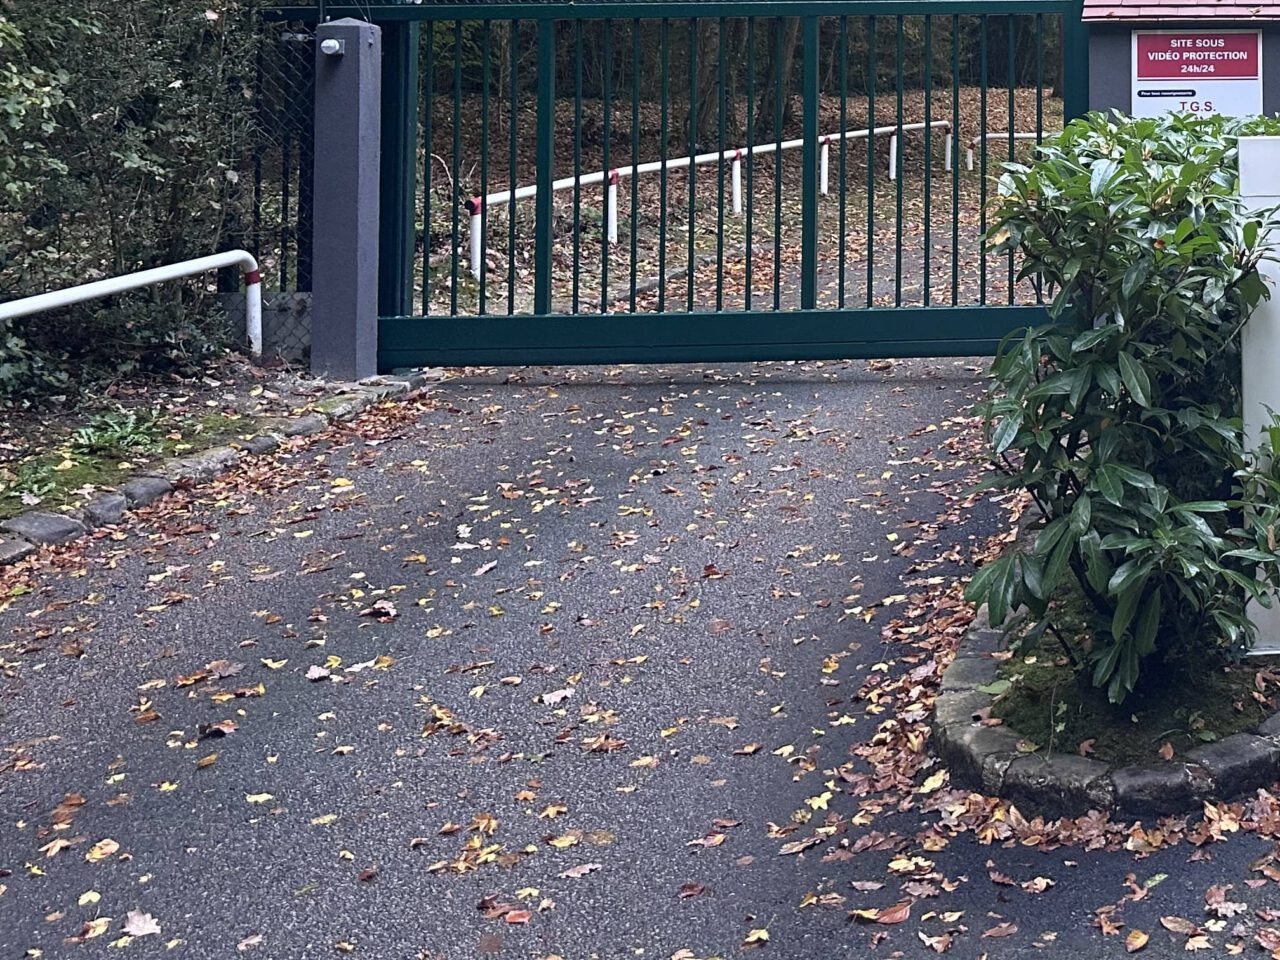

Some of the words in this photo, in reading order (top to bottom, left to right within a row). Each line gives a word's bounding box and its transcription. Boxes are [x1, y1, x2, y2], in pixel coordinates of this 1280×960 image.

[1170, 39, 1193, 47] SITE
[1196, 39, 1225, 47] SOUS
[1148, 50, 1180, 60] VIDÉO
[1183, 52, 1248, 60] PROTECTION
[1180, 65, 1215, 73] 24h/24
[1179, 101, 1216, 112] T.G.S.
